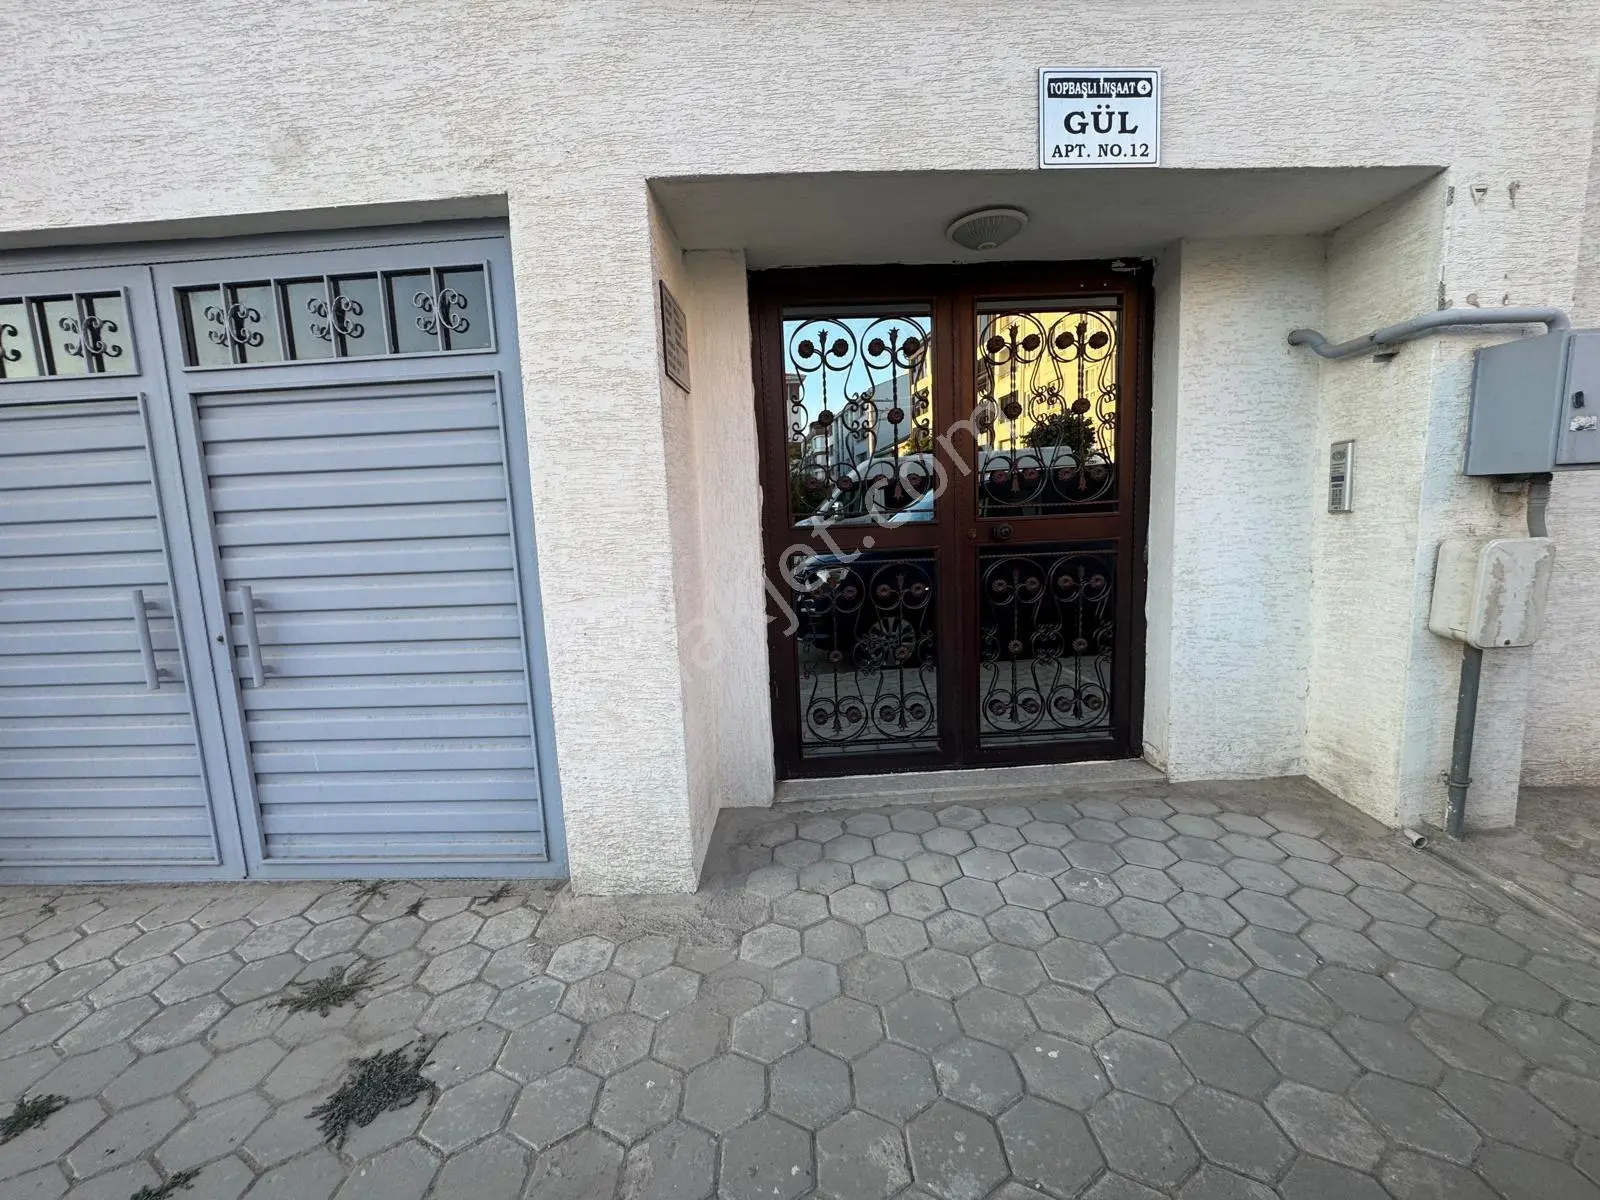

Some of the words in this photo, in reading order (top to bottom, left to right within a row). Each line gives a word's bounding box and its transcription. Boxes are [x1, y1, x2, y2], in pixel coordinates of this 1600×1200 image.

[1063, 104, 1138, 134] GÜL
[1051, 144, 1091, 158] APT.
[1097, 143, 1149, 158] NO.12
